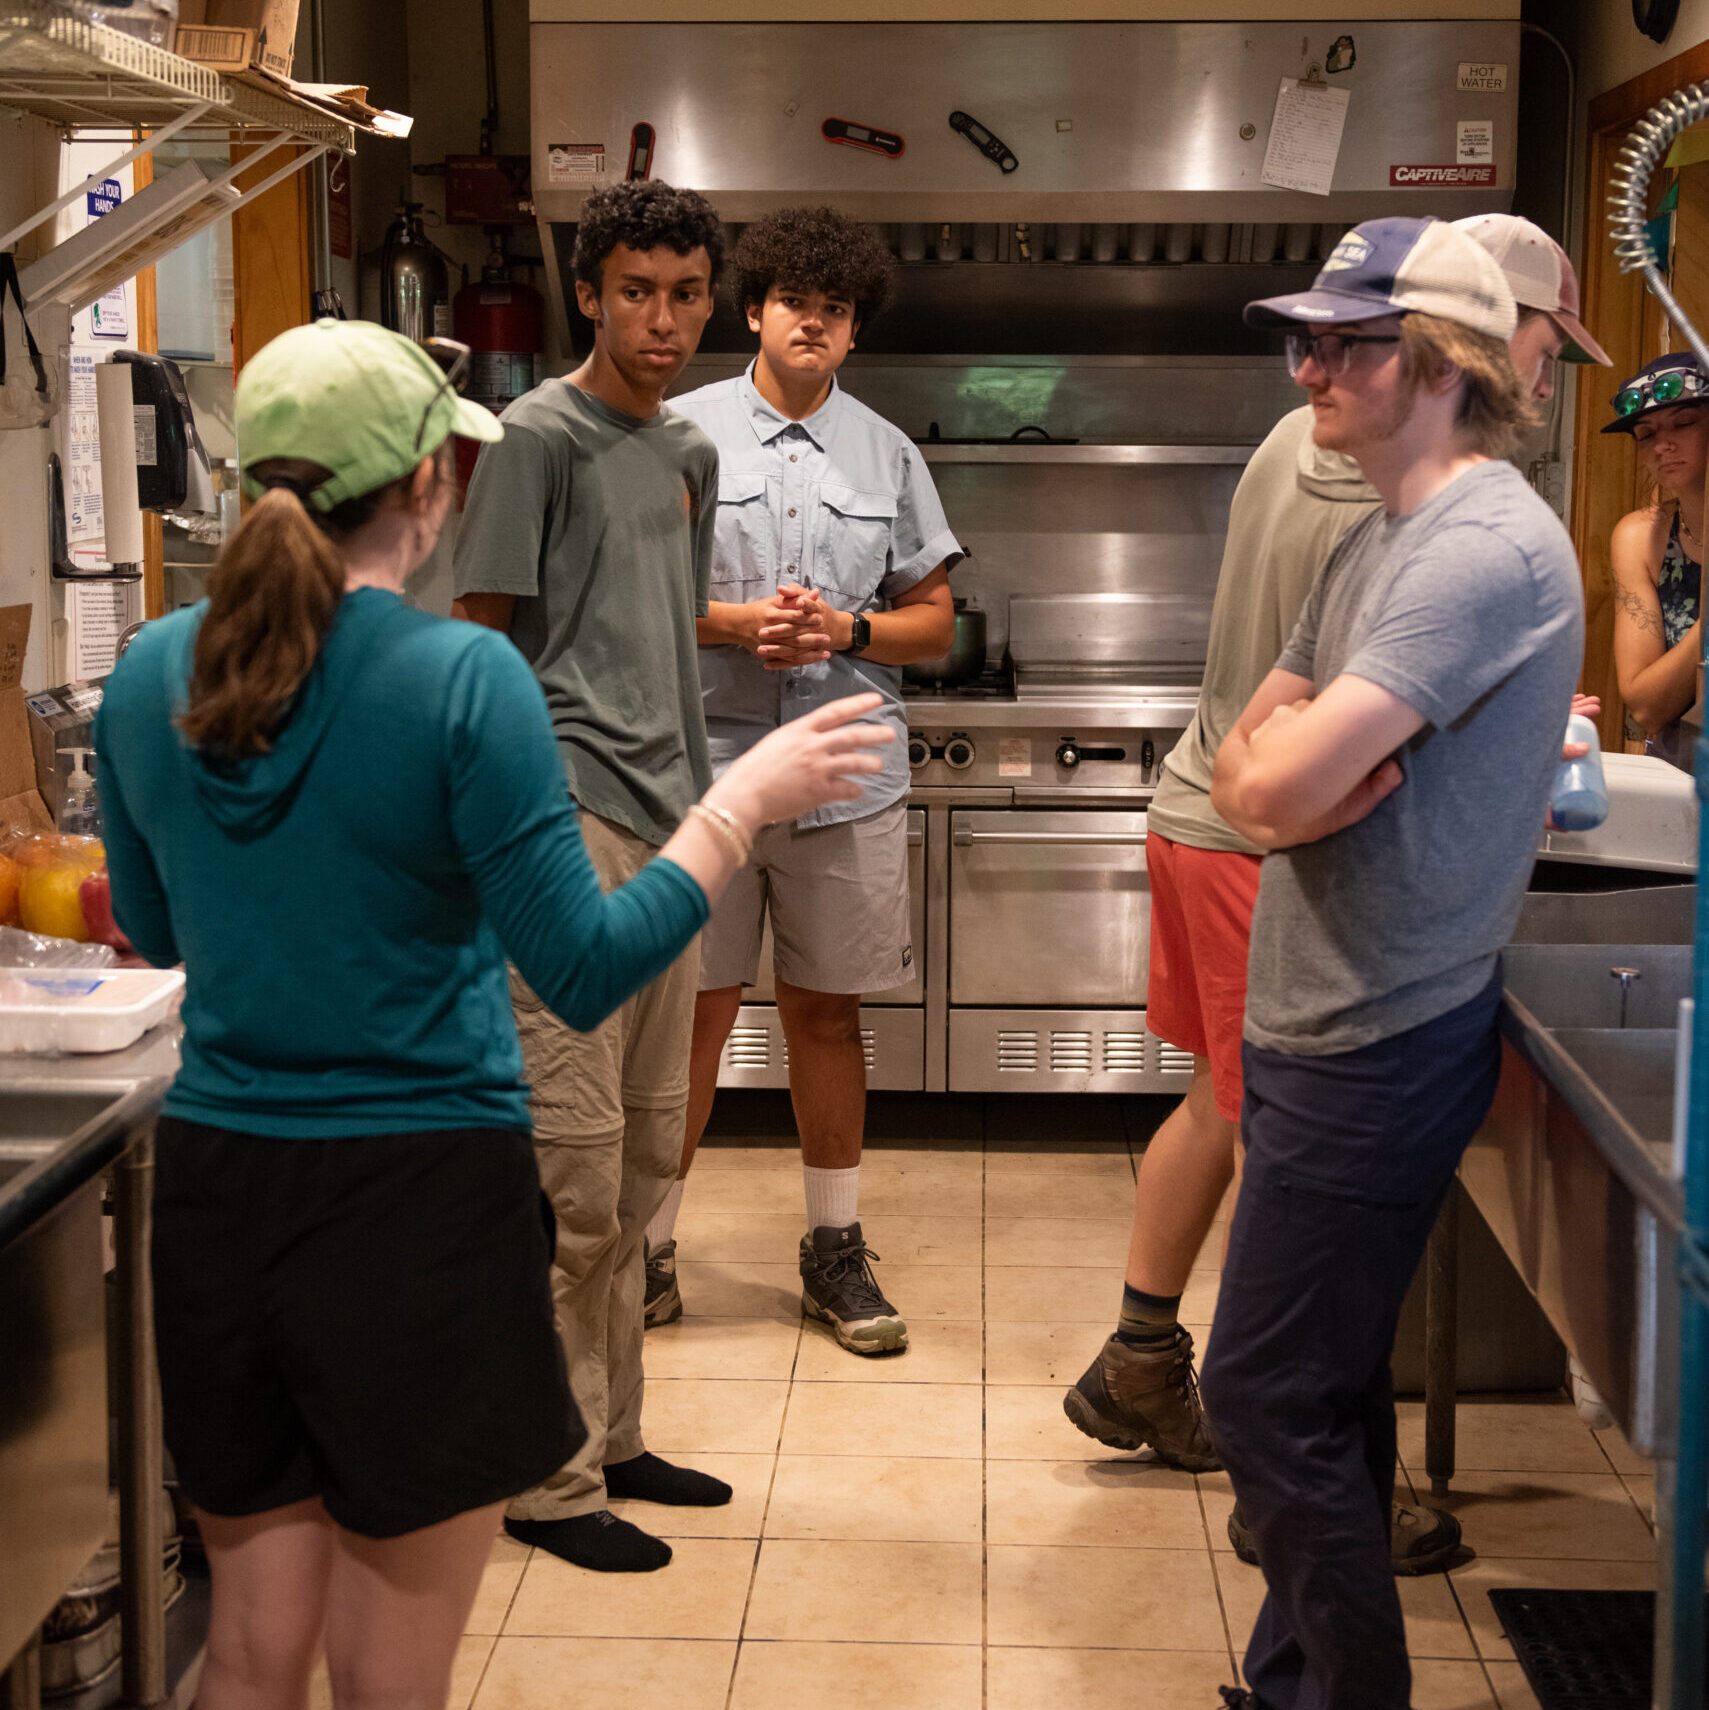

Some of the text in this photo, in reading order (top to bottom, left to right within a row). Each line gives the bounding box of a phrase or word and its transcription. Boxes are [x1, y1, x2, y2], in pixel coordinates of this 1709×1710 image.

[1469, 66, 1496, 77] HOT
[1461, 77, 1502, 88] WATER
[1395, 166, 1492, 182] CAPTIVEAIRE
[105, 183, 120, 200] YOUR
